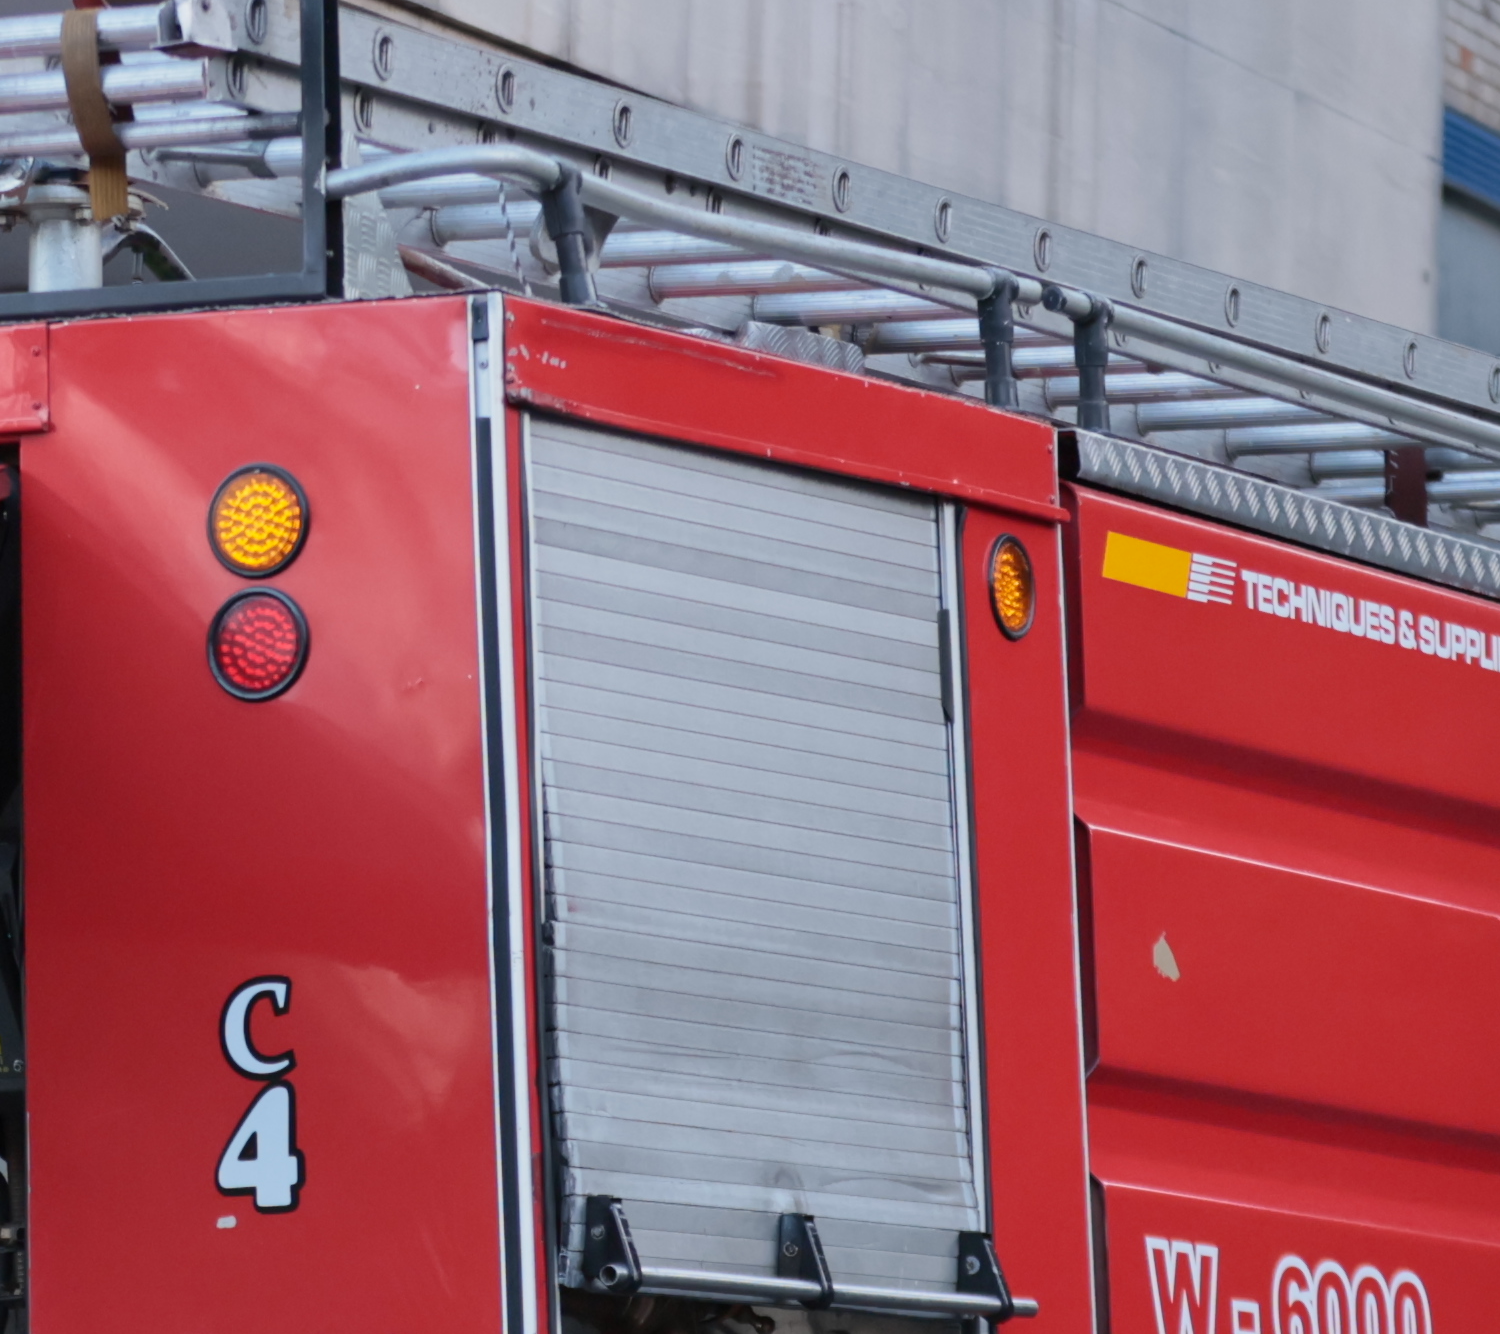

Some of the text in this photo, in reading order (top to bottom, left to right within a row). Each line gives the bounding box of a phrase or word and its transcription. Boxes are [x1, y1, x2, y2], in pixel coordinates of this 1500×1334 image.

[1240, 569, 1396, 645] TECHNIQUES
[1399, 609, 1417, 650] &
[218, 974, 296, 1082] C
[214, 1077, 306, 1215] 4
